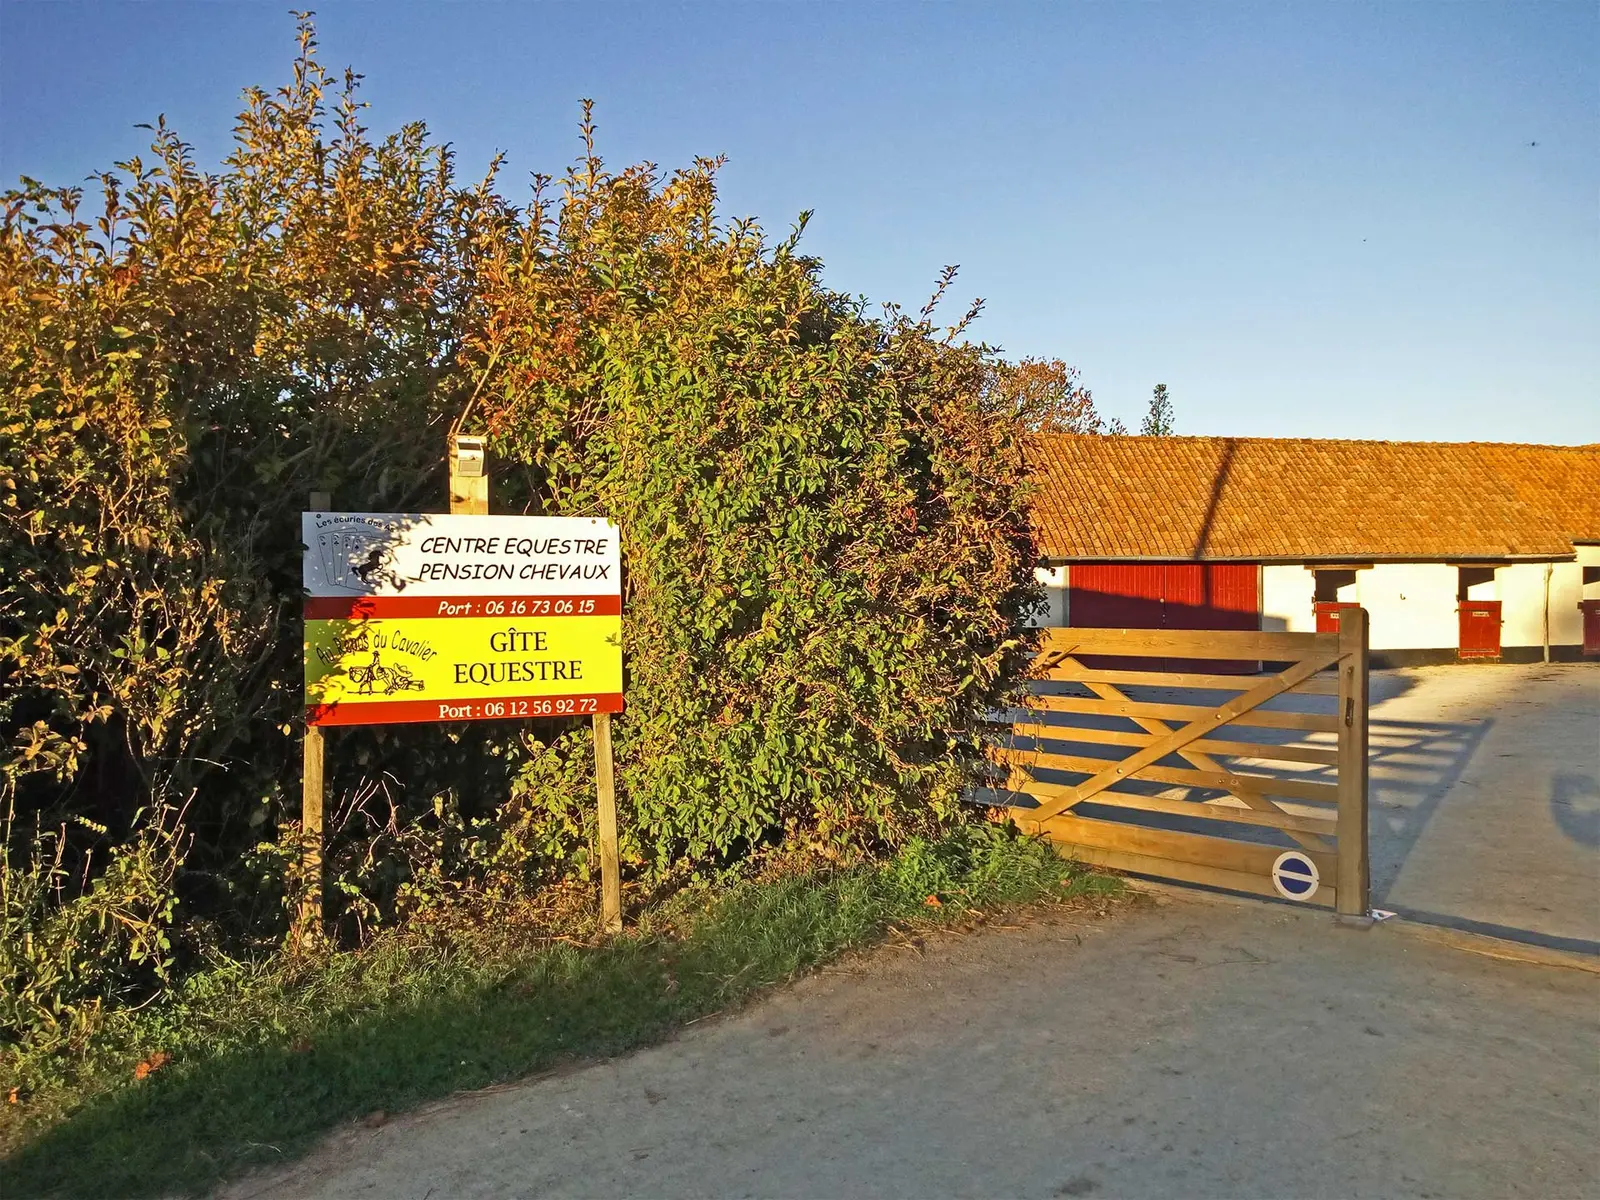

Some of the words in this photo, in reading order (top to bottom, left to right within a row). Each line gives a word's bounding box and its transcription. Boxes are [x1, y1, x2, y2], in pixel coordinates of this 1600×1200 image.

[316, 519, 332, 529] Les
[334, 516, 366, 524] écuries
[368, 518, 383, 528] des
[420, 537, 499, 554] CENTRE
[505, 538, 608, 555] EQUESTRE
[419, 564, 514, 580] PENSION
[520, 565, 610, 580] CHEVAUX
[485, 602, 505, 614] 06
[508, 601, 526, 614] 16
[532, 602, 549, 614] 73
[554, 601, 573, 614] 06
[578, 600, 595, 613] 15
[316, 647, 333, 665] Au
[373, 630, 387, 648] du
[391, 630, 437, 662] Cavalier
[490, 628, 548, 652] GÎTE
[454, 660, 582, 686] EQUESTRE
[485, 703, 504, 716] 06
[509, 702, 527, 715] 12
[533, 701, 551, 714] 56
[556, 700, 575, 713] 92
[579, 699, 598, 712] 72
